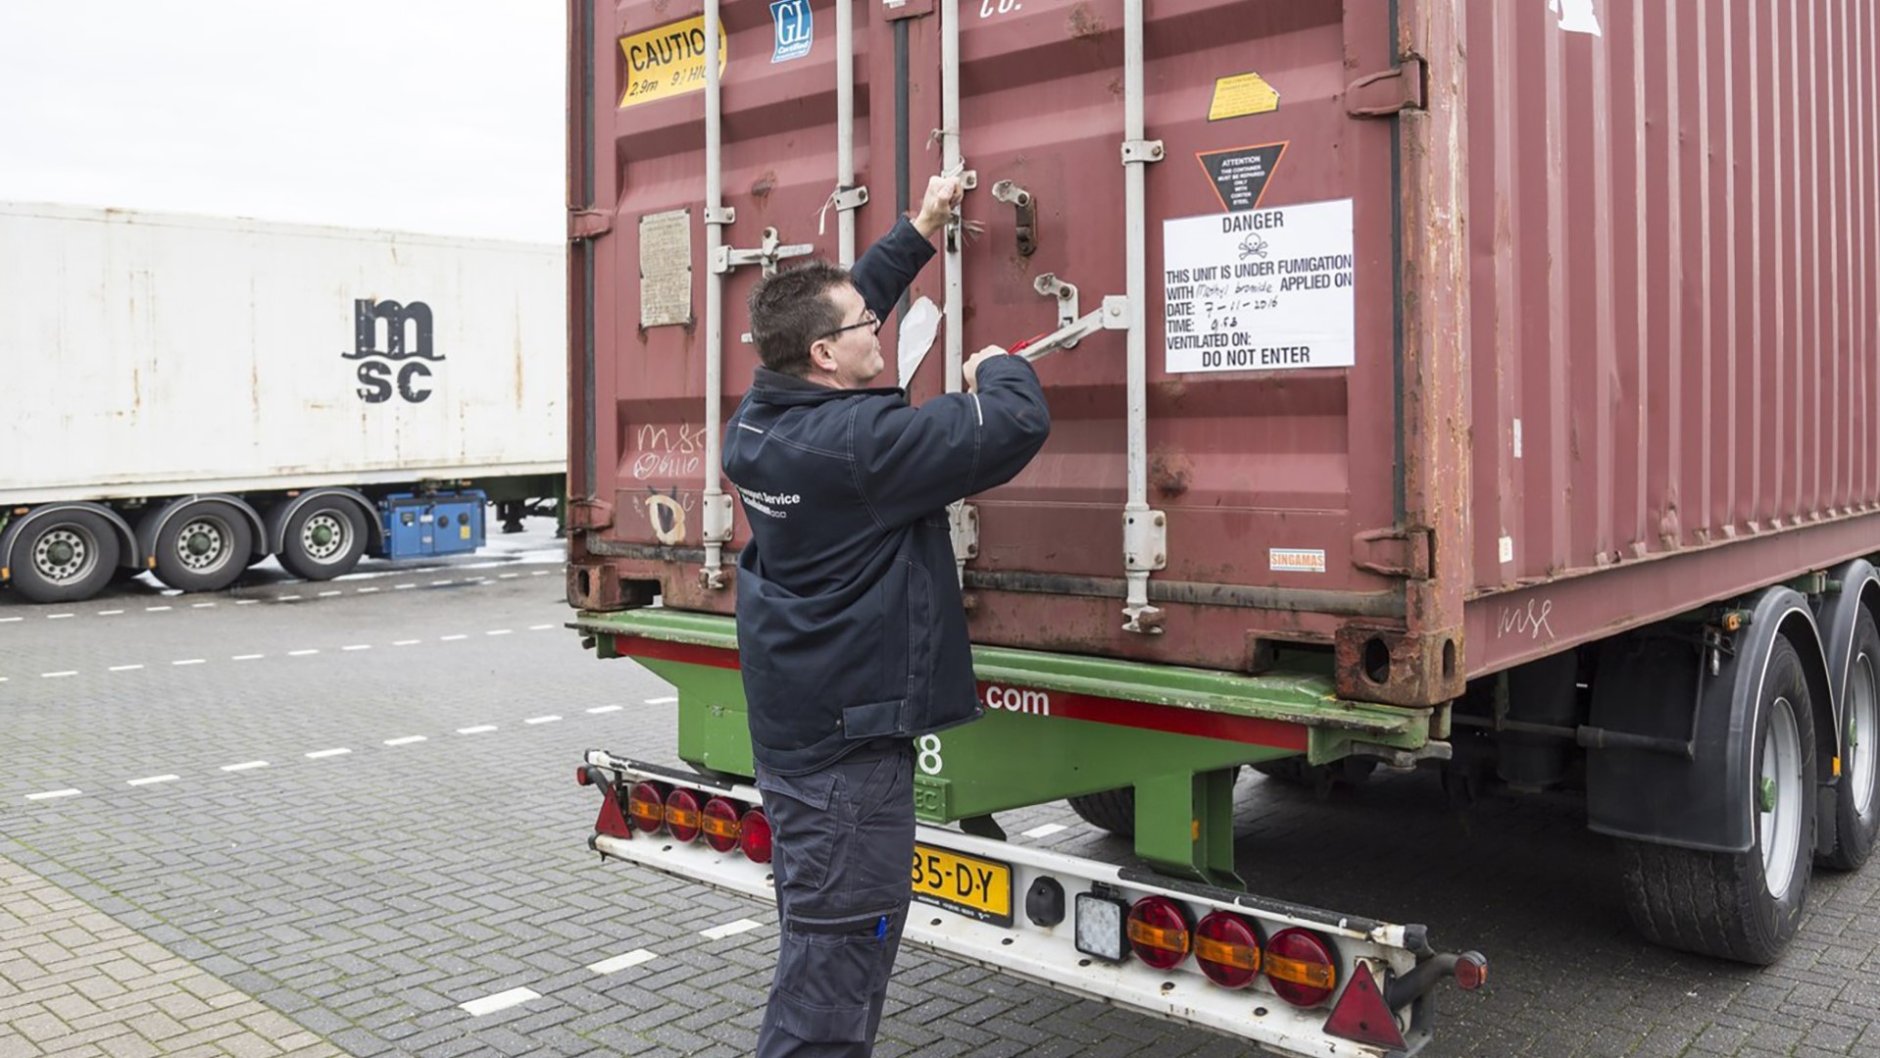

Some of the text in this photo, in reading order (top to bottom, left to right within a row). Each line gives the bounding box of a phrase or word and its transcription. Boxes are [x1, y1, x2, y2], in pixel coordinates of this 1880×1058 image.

[778, 1, 810, 45] GL
[630, 28, 721, 71] CAUTIO
[1222, 156, 1261, 167] ATTENTION
[1222, 211, 1284, 233] DANGER
[1166, 254, 1352, 285] THIS UNIT IS UNDER FUMIGATION
[1166, 285, 1194, 300] WITH
[1280, 273, 1331, 292] APPLIED
[1335, 272, 1352, 287] ON
[1167, 301, 1195, 317] DATE:
[1167, 319, 1195, 333] TIME:
[1167, 332, 1251, 350] VENTILATED ON:
[1202, 346, 1311, 368] DO NOT ENTER
[1271, 553, 1324, 567] SINGAMAS
[918, 734, 943, 775] 8
